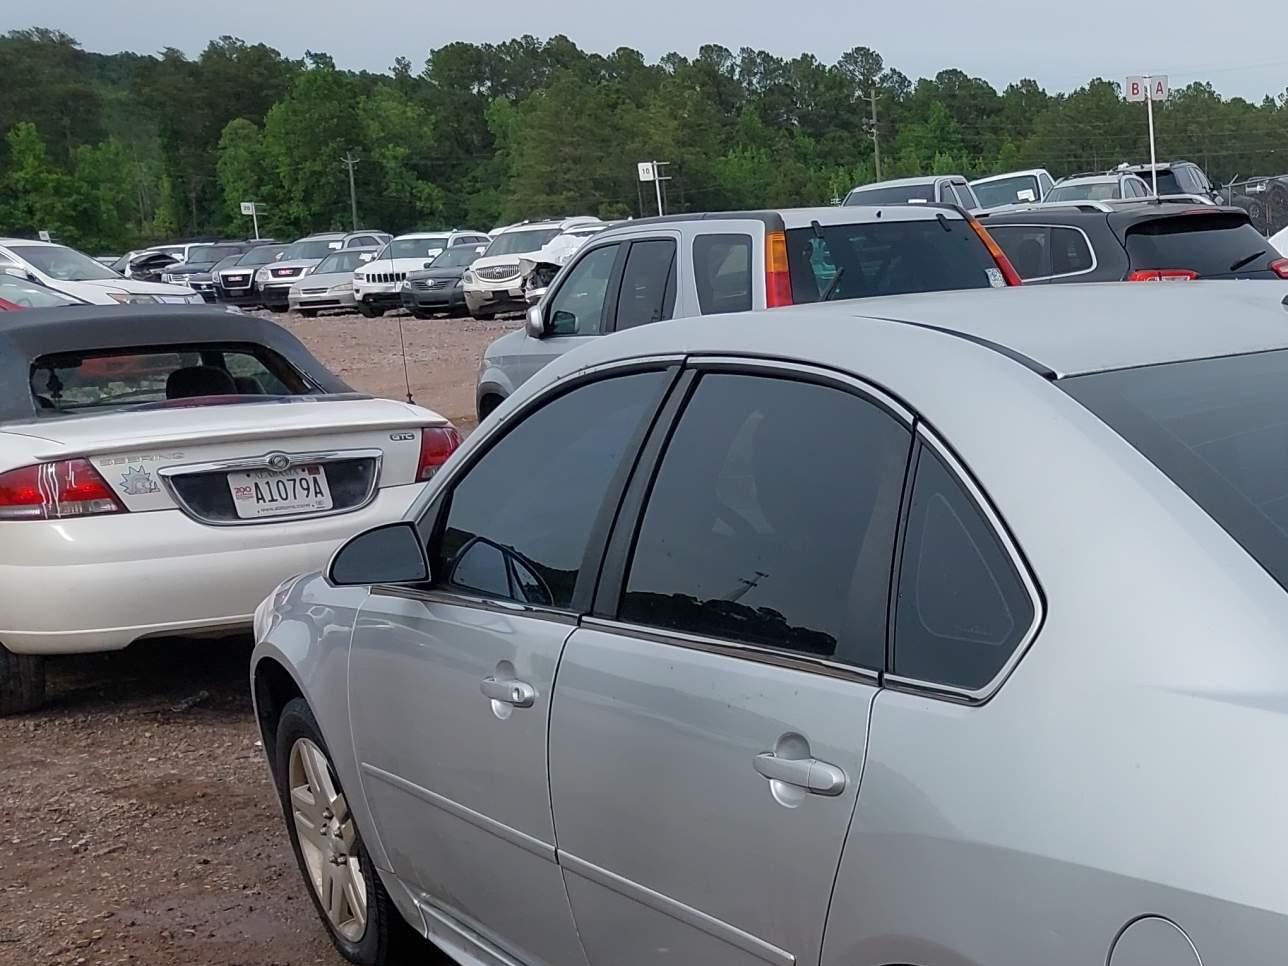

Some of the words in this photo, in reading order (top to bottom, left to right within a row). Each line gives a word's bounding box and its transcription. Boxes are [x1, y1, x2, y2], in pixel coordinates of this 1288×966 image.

[1131, 82, 1140, 95] B
[1155, 82, 1164, 95] A
[254, 476, 325, 504] A1079A
